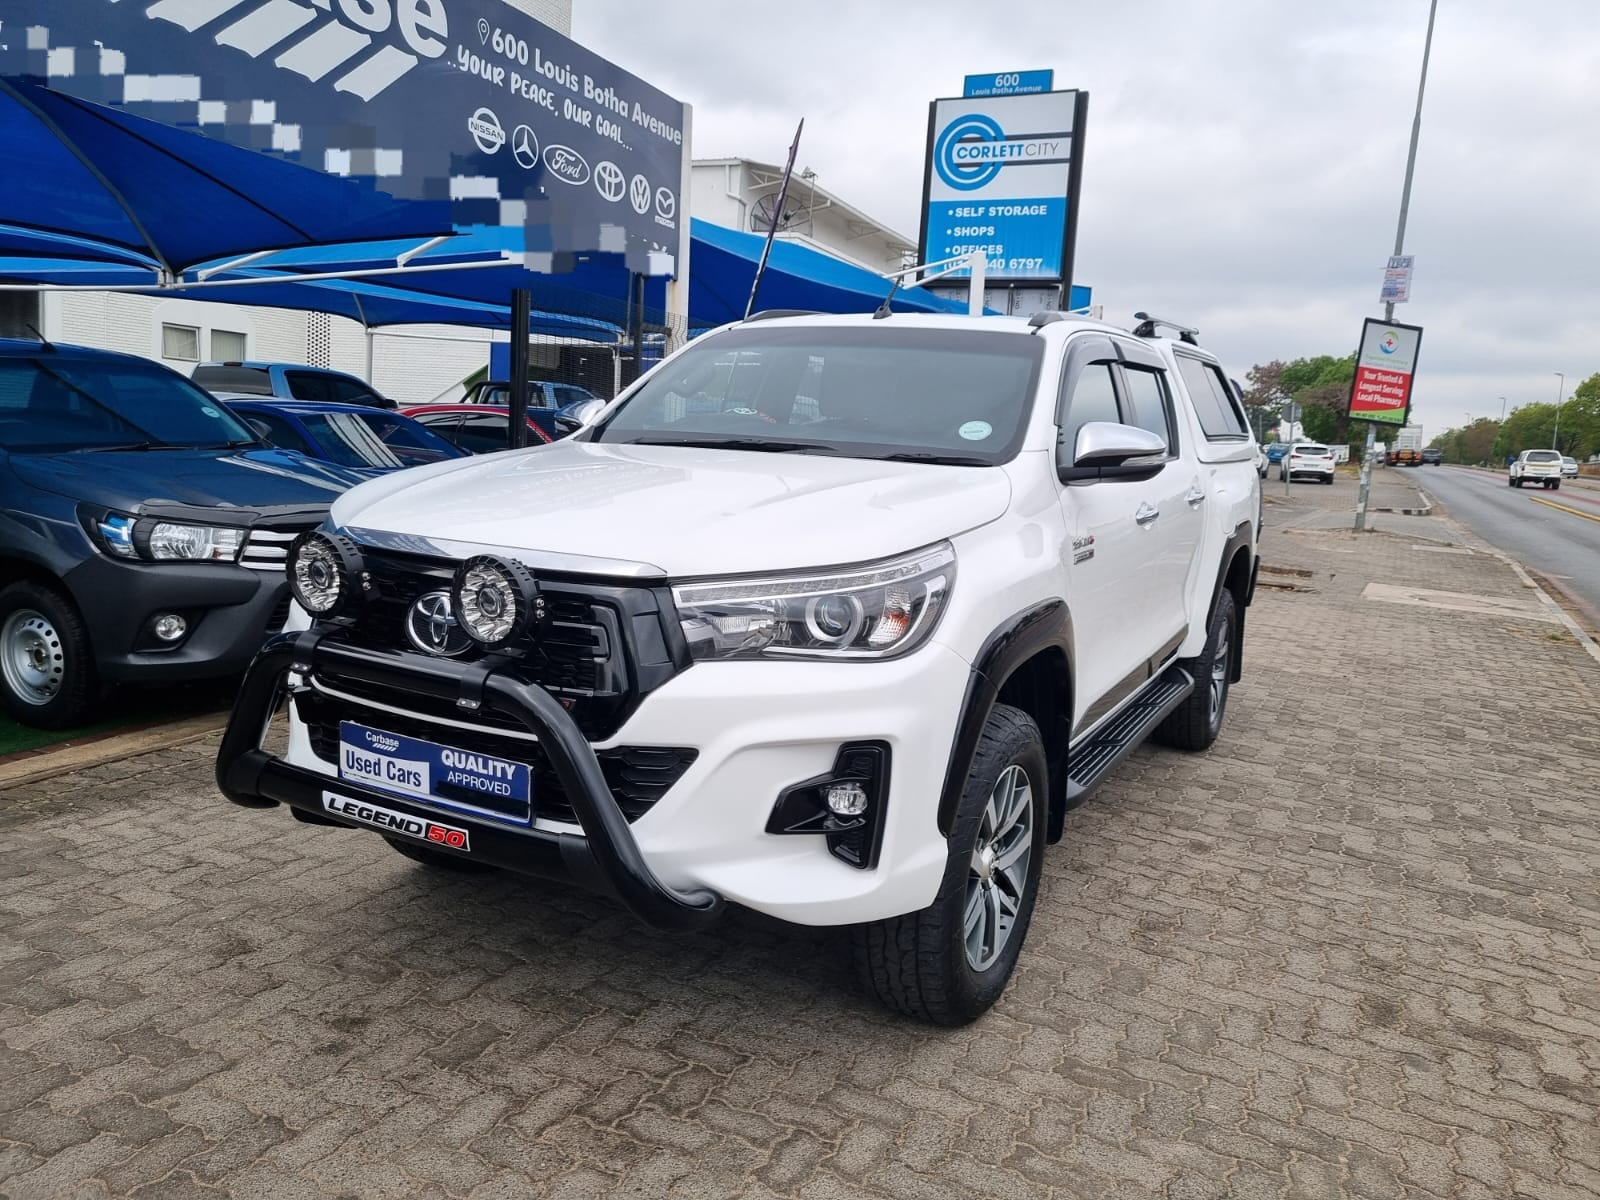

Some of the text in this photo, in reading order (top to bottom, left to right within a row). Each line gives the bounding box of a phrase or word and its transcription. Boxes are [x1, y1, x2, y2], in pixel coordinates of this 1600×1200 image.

[492, 27, 682, 146] 600 Louis Botha Avenue
[971, 84, 1042, 96] Louis Botha Avenue
[995, 73, 1020, 87] 600
[563, 98, 592, 129] OUR
[470, 120, 504, 142] NISSAN
[551, 149, 583, 180] Ford
[954, 205, 1048, 218] SELF STORAGE
[953, 226, 995, 237] SHOPS
[985, 258, 1005, 269] 40
[1009, 258, 1043, 269] 6797
[1357, 391, 1402, 408] Local Pharmacy
[365, 731, 400, 748] Carbase
[346, 749, 422, 787] Used Cars
[440, 750, 516, 780] QUALITY
[447, 771, 511, 796] APPROVED
[327, 798, 424, 835] LEGEND
